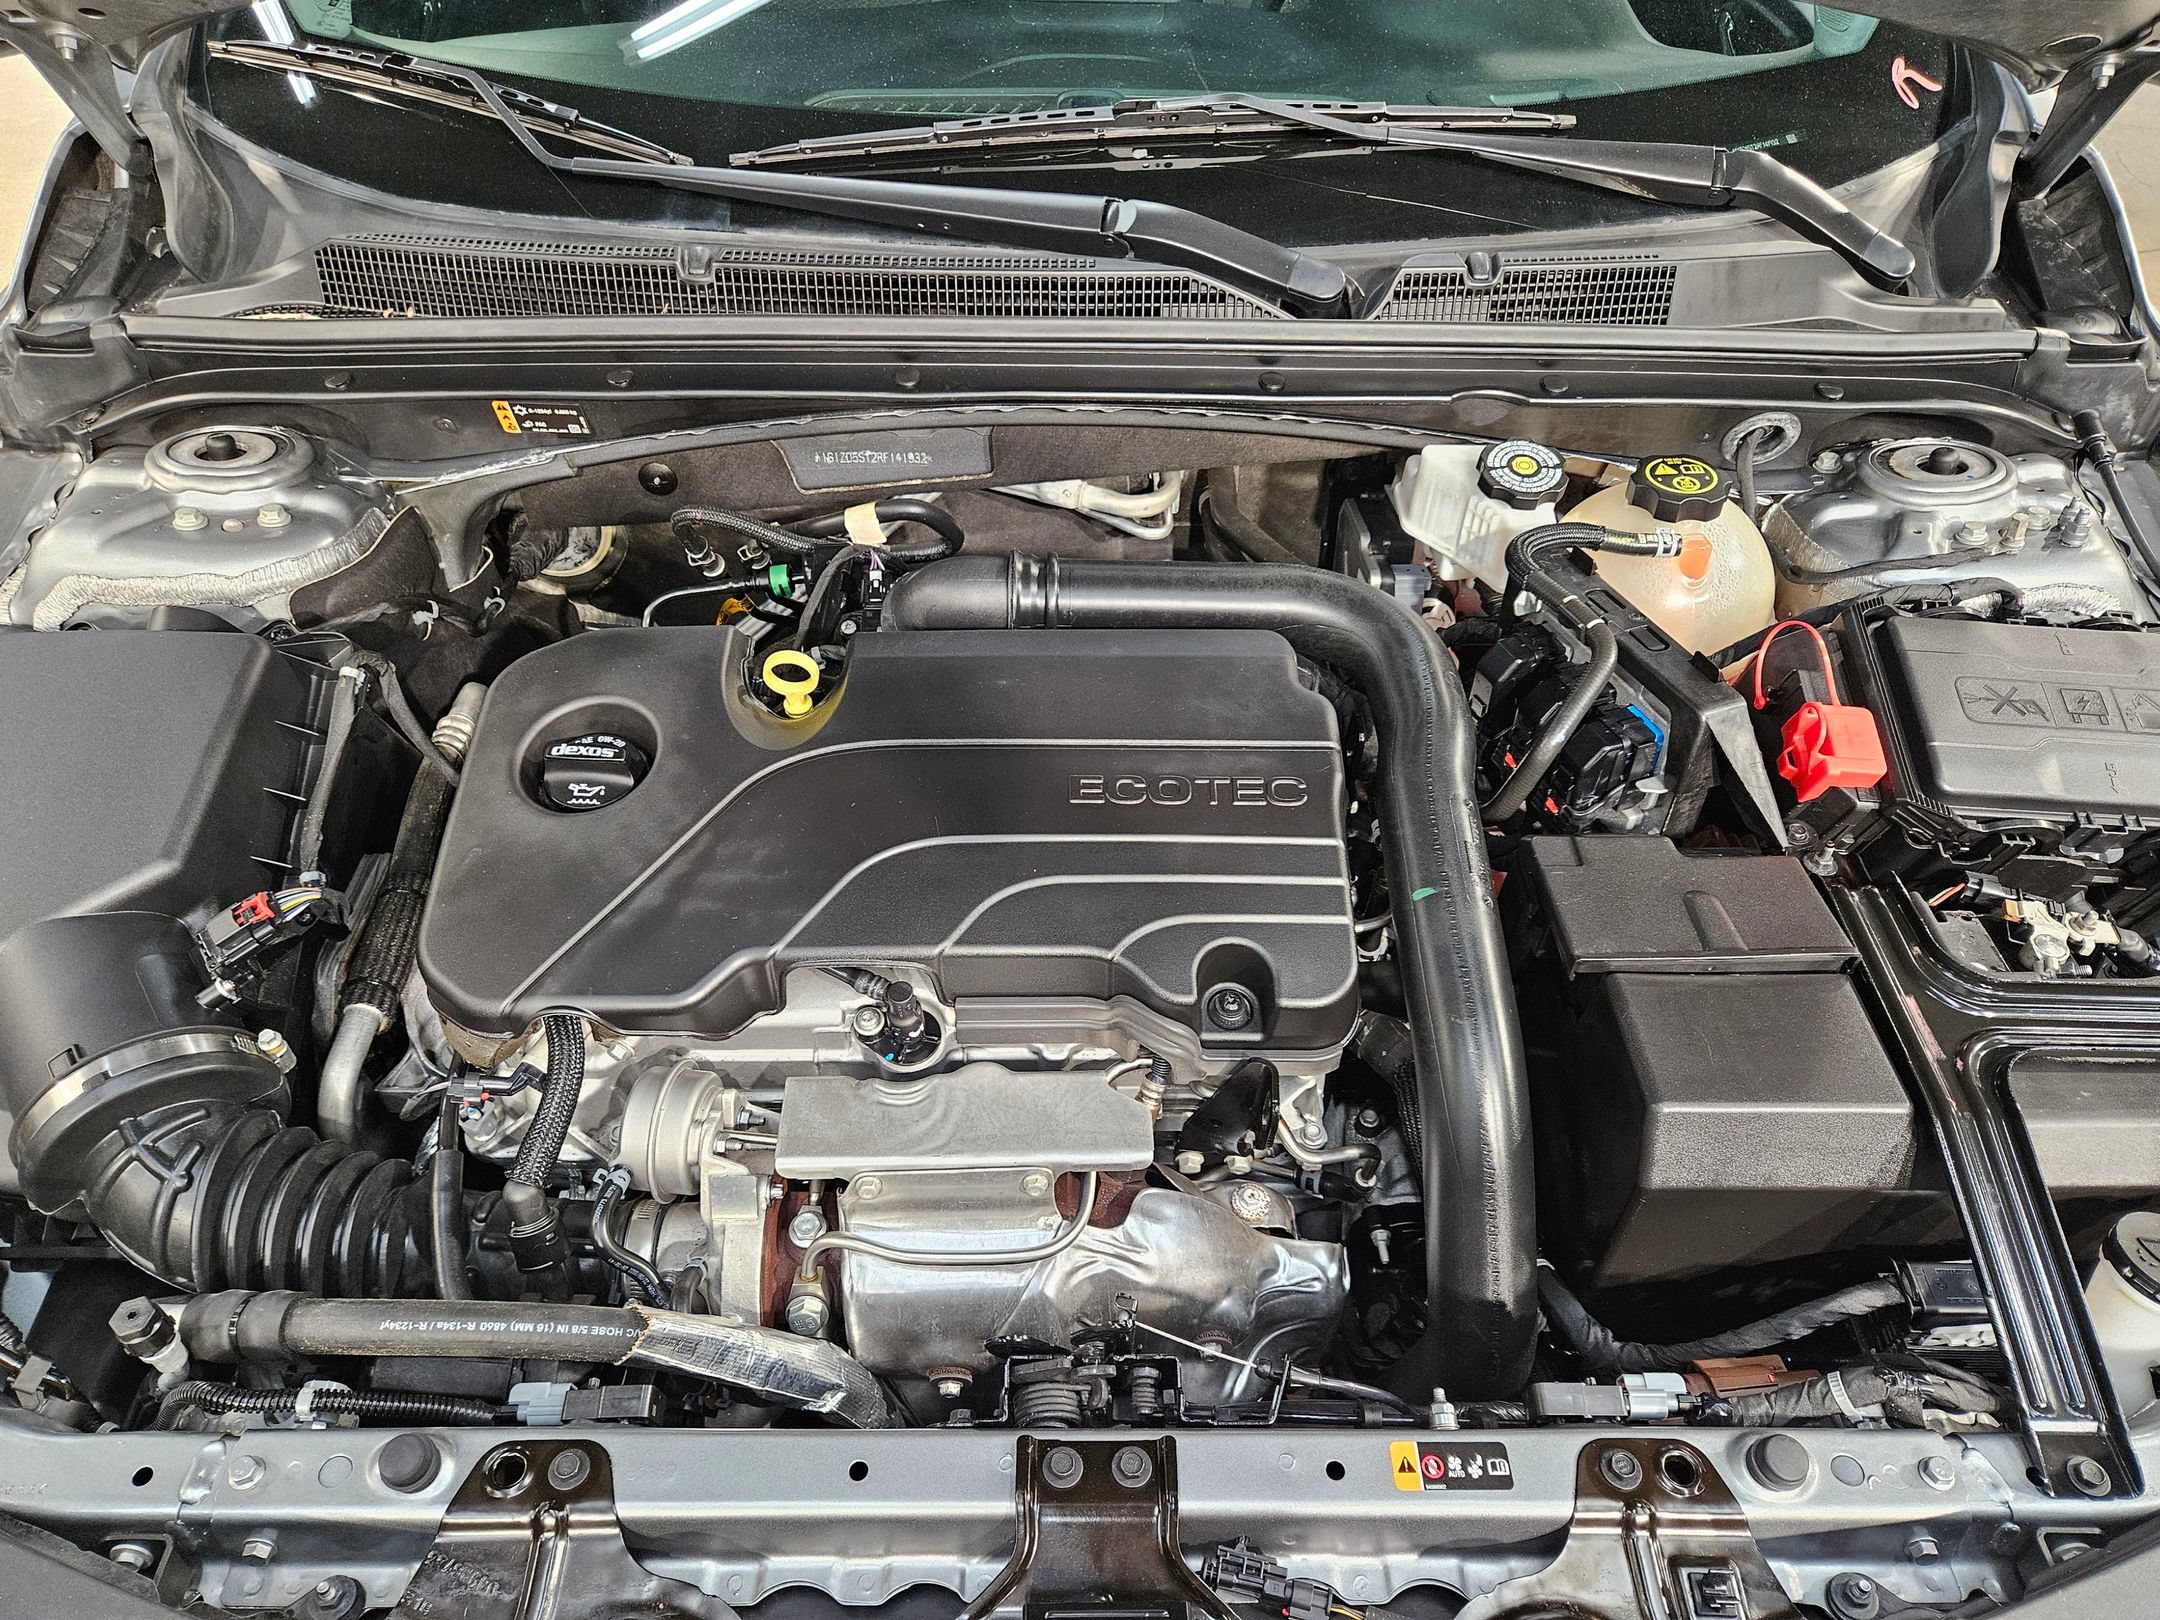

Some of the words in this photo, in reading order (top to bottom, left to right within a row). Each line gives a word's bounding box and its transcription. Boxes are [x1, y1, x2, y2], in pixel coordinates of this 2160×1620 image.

[1068, 774, 1309, 807] ECOTEC
[379, 1320, 427, 1331] R-1234yf
[437, 1321, 476, 1331] R-134a
[480, 1322, 507, 1331] 4860
[510, 1321, 535, 1333] MM)
[537, 1322, 554, 1333] (16
[557, 1324, 570, 1334] IN
[572, 1324, 589, 1335] 5/8
[591, 1326, 624, 1336] HOSE
[1448, 1470, 1466, 1478] AUTO
